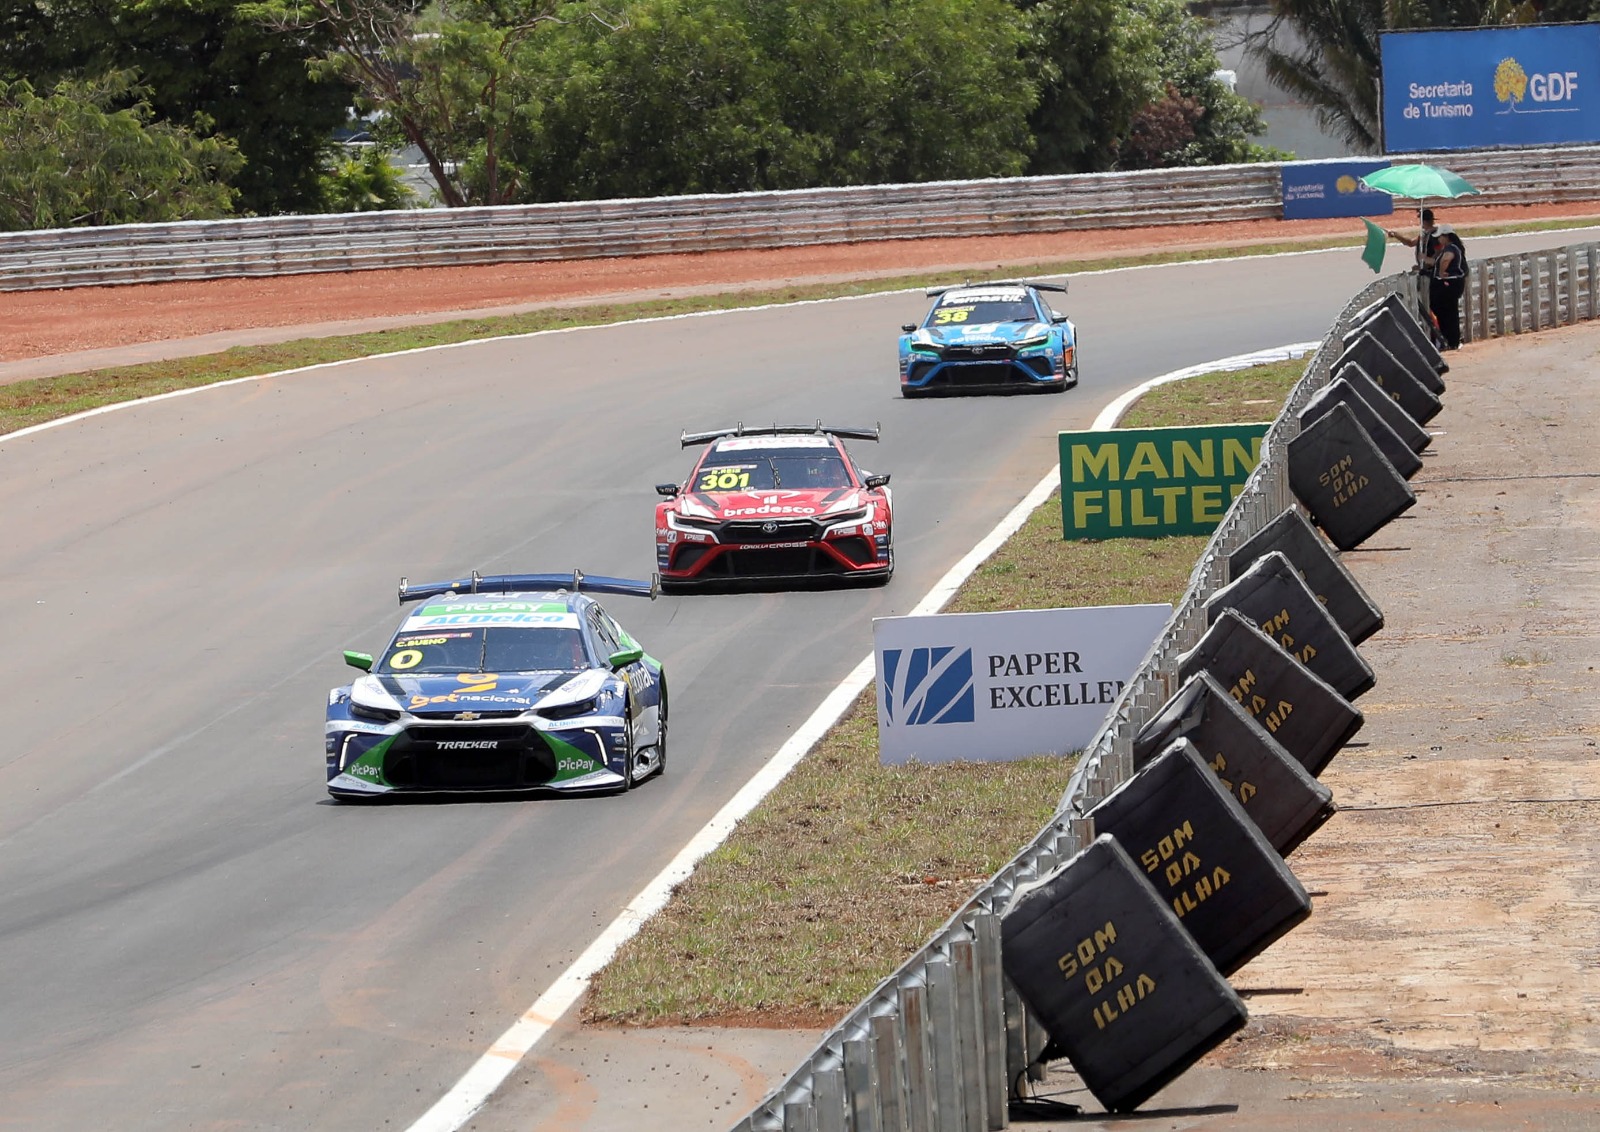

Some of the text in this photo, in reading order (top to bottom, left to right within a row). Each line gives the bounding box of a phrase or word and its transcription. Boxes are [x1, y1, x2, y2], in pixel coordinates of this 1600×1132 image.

[1409, 79, 1473, 99] Secretaria
[1529, 71, 1579, 102] GDF
[1403, 102, 1474, 119] de Turismo
[935, 311, 968, 324] 38
[1071, 437, 1263, 482] MANN
[1319, 454, 1353, 487] SOM
[699, 472, 750, 490] 301
[1333, 475, 1369, 508] ILHA
[723, 505, 816, 517] bradesco
[423, 614, 565, 626] ACDelco
[445, 601, 544, 613] PicPay
[1261, 608, 1290, 637] OM
[395, 637, 448, 648] C.BUENO
[988, 651, 1083, 678] PAPER
[1228, 669, 1256, 703] OM
[1265, 700, 1293, 733] HA
[435, 740, 498, 750] TRACKER
[351, 762, 381, 778] PicPay
[557, 757, 594, 772] PicPay
[1140, 819, 1194, 874] SOM
[1173, 866, 1231, 918] ILHA
[1057, 920, 1117, 981] SOM
[1092, 973, 1157, 1031] ILHA
